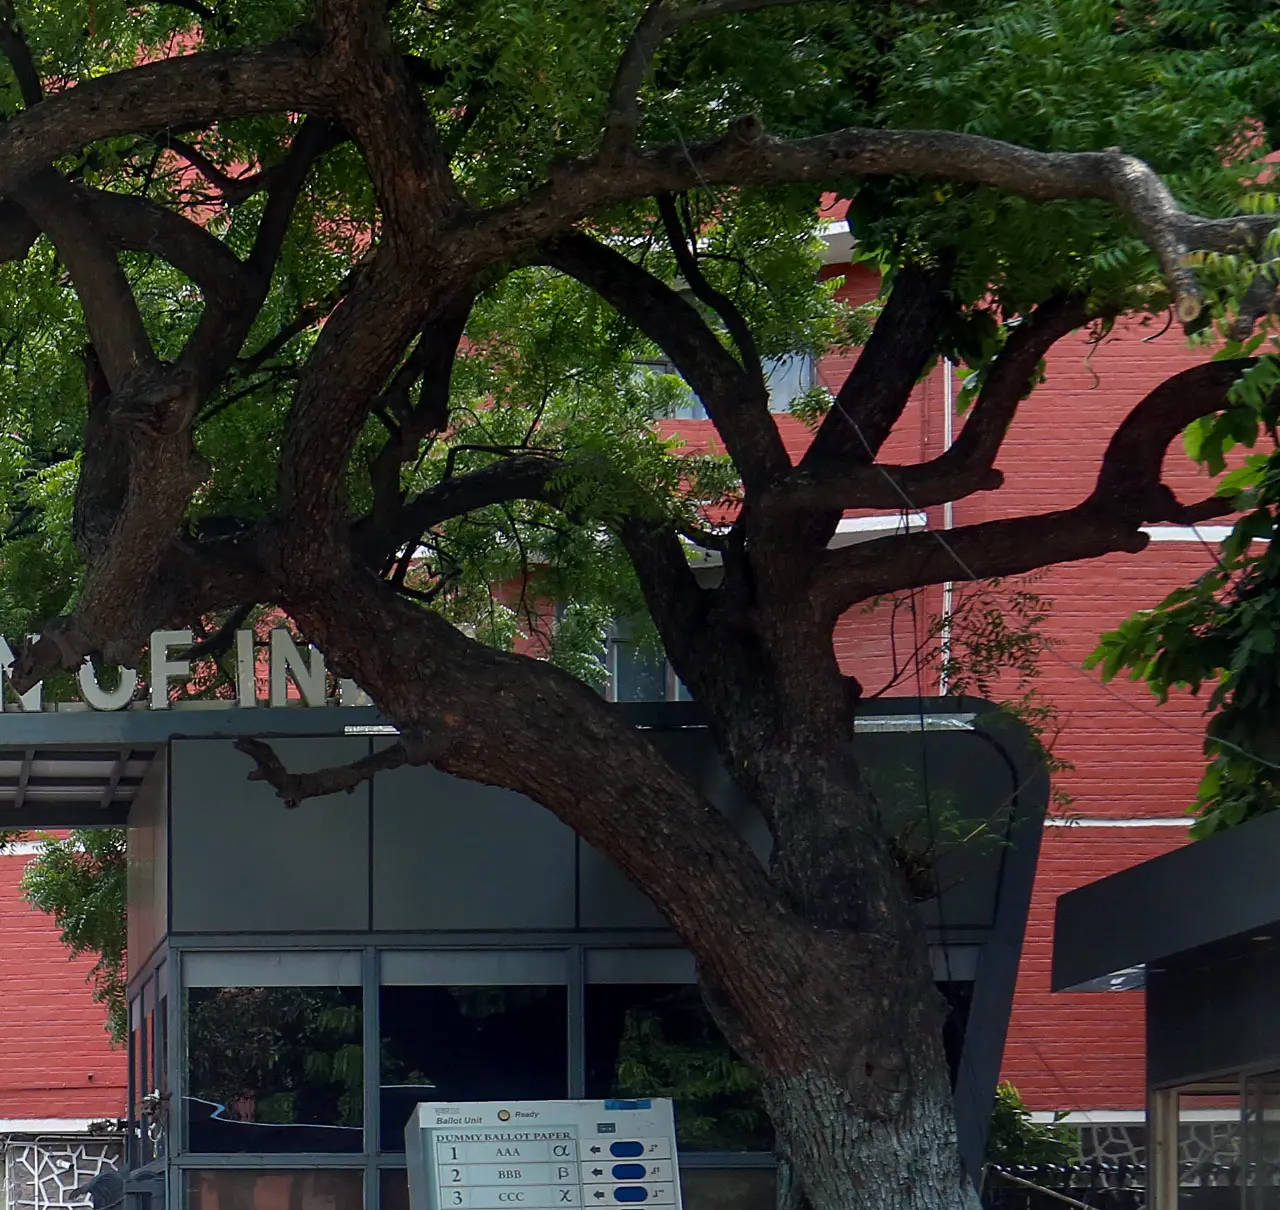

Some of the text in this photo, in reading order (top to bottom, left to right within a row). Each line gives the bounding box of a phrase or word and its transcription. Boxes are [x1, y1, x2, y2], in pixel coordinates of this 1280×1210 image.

[436, 1116, 482, 1125] Ballot Unit
[515, 1111, 539, 1119] Ready
[436, 1132, 572, 1142] DUMMY BALLOT PAPER
[450, 1146, 458, 1160] 1
[495, 1148, 521, 1157] AAA
[452, 1169, 462, 1182] 2
[498, 1170, 522, 1179] BBB
[453, 1191, 463, 1205] 3
[498, 1192, 525, 1202] CCC
